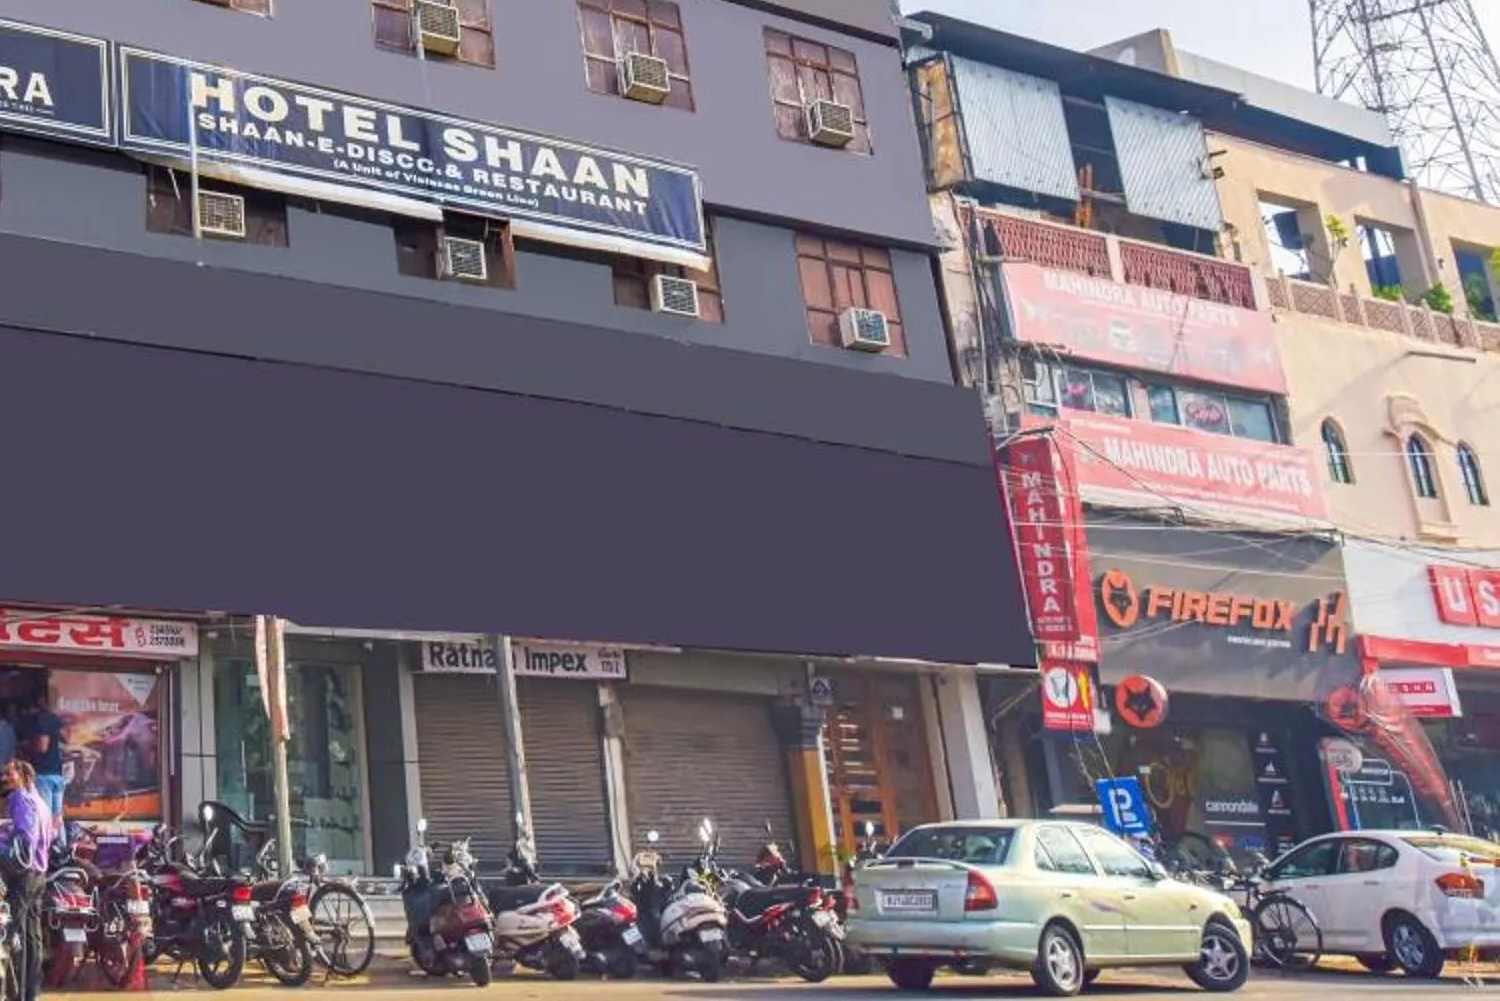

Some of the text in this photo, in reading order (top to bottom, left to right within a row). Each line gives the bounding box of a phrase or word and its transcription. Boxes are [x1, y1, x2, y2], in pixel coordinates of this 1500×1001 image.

[191, 72, 650, 200] HOTEL SHAAN
[352, 162, 382, 176] Unit
[385, 168, 400, 180] of
[473, 167, 648, 216] RESTAURANT
[1104, 438, 1204, 481] MAHINDRA
[1208, 453, 1254, 488] AUTO
[1258, 462, 1312, 498] PARTS
[1147, 583, 1293, 632] FIREFOX
[428, 642, 517, 669] Ratna
[524, 646, 588, 674] Impex
